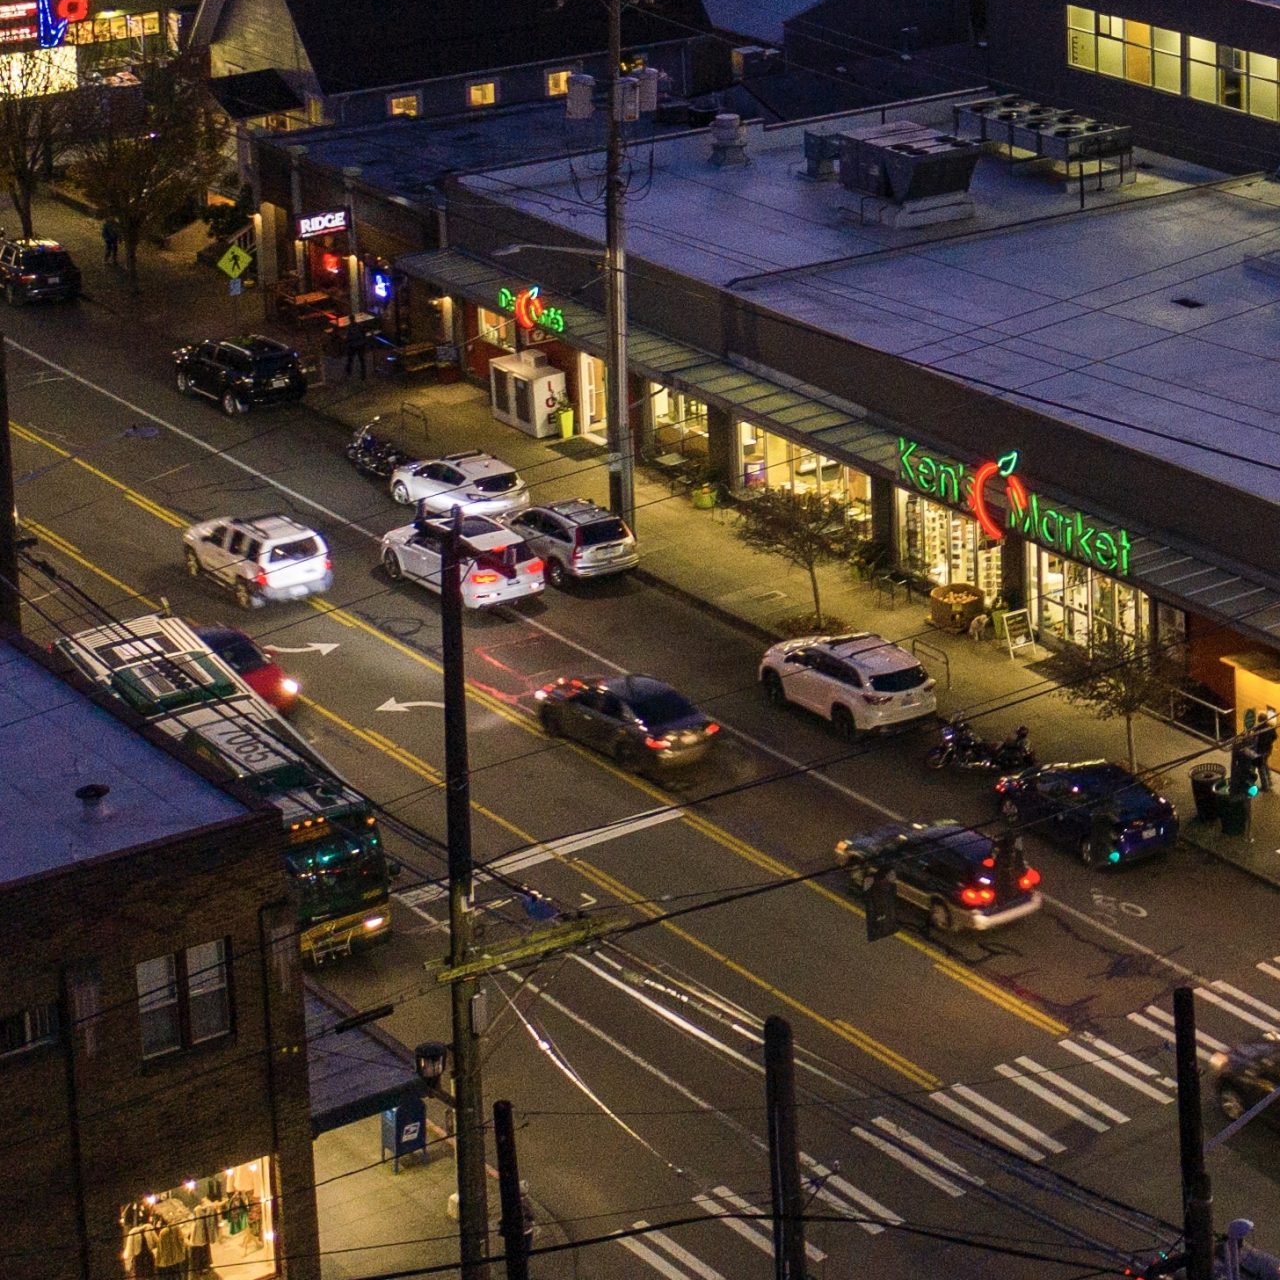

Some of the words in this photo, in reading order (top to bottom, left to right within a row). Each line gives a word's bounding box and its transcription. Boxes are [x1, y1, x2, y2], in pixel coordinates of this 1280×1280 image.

[300, 211, 346, 233] RIDGE
[545, 380, 557, 425] ICE
[899, 437, 976, 505] Ken's
[1009, 488, 1131, 576] Market
